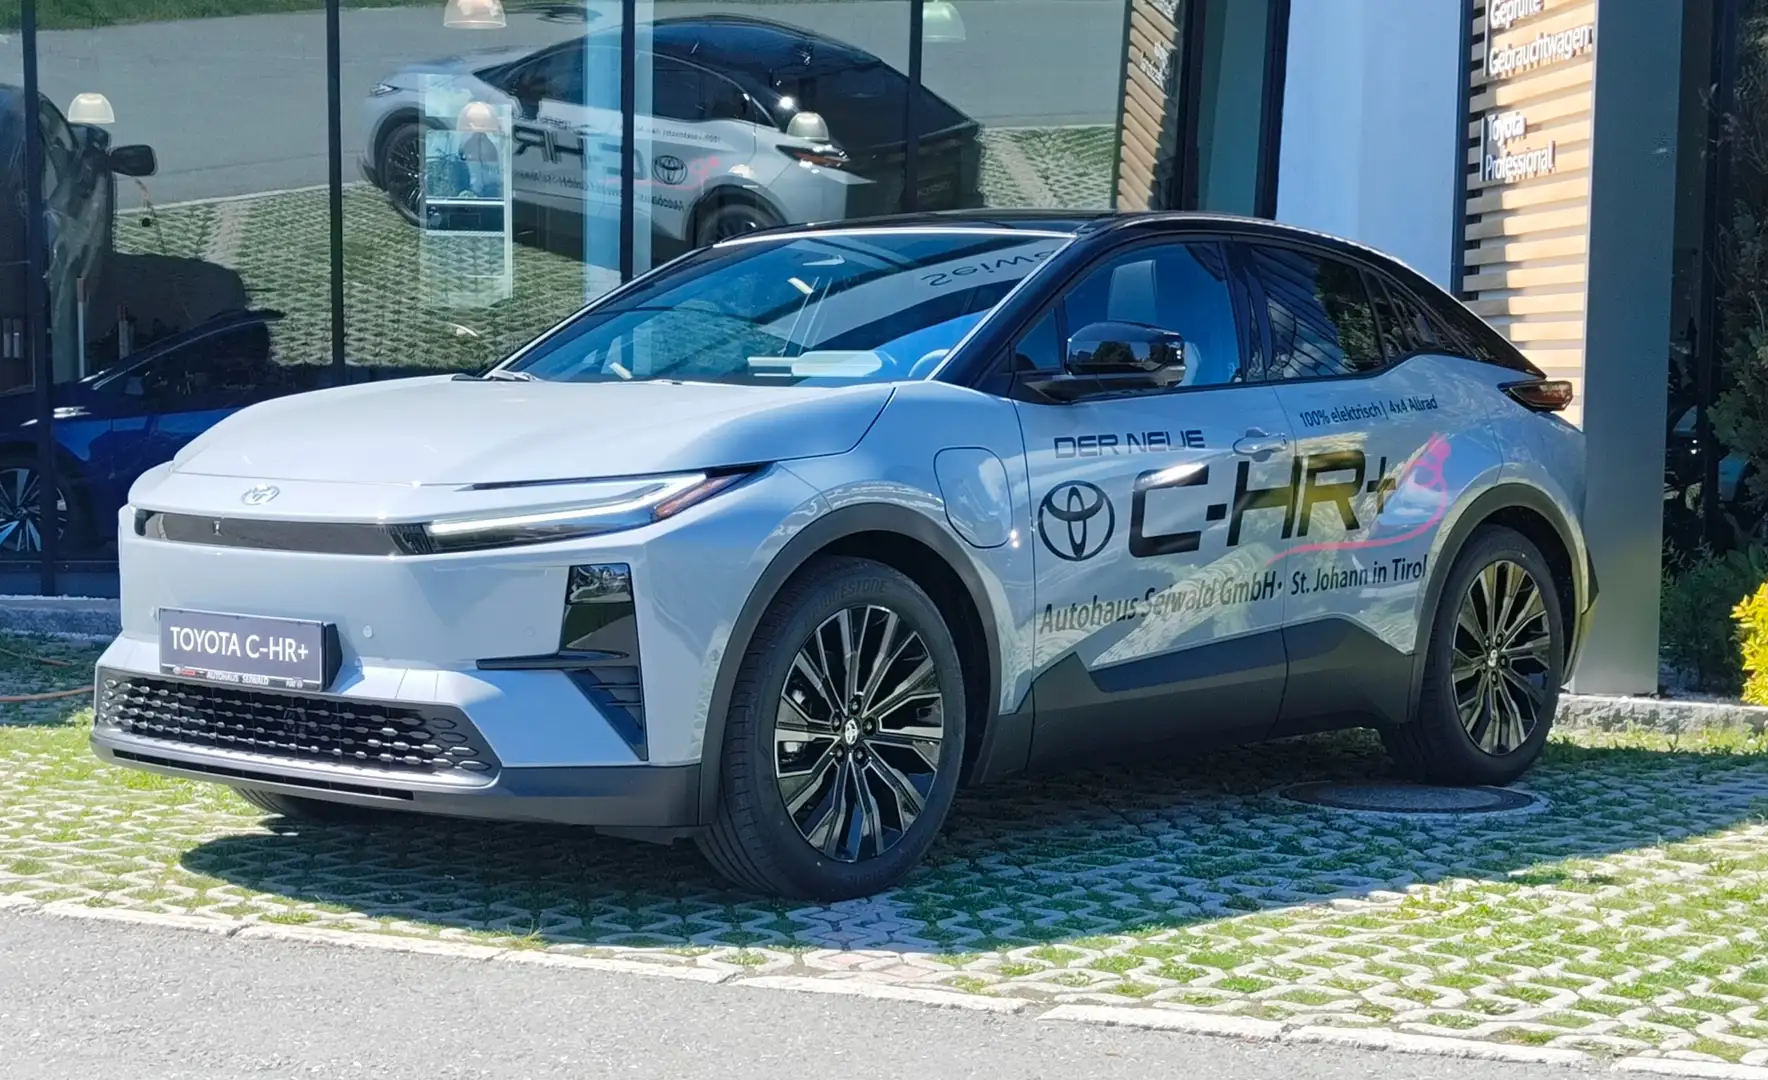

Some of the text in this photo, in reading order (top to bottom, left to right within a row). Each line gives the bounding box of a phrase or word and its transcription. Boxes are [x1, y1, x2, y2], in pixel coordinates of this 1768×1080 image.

[1489, 25, 1589, 75] Gebrauchtwagen
[1487, 113, 1526, 147] Toyota
[1485, 140, 1554, 182] Professional
[1300, 409, 1330, 427] 100%
[1331, 402, 1382, 422] elektrisch
[1389, 400, 1408, 414] 4x4
[1409, 394, 1438, 411] Allrad
[1054, 430, 1205, 458] DER NEUE
[1128, 450, 1397, 558] C-HR+
[1039, 595, 1138, 634] Autohaus
[1141, 578, 1216, 618] Seiwald
[1291, 571, 1310, 595] St.
[1313, 566, 1368, 592] Johann
[1372, 561, 1387, 584] in
[1392, 554, 1428, 581] Tirol
[170, 626, 309, 663] TOYOTA C-HR+
